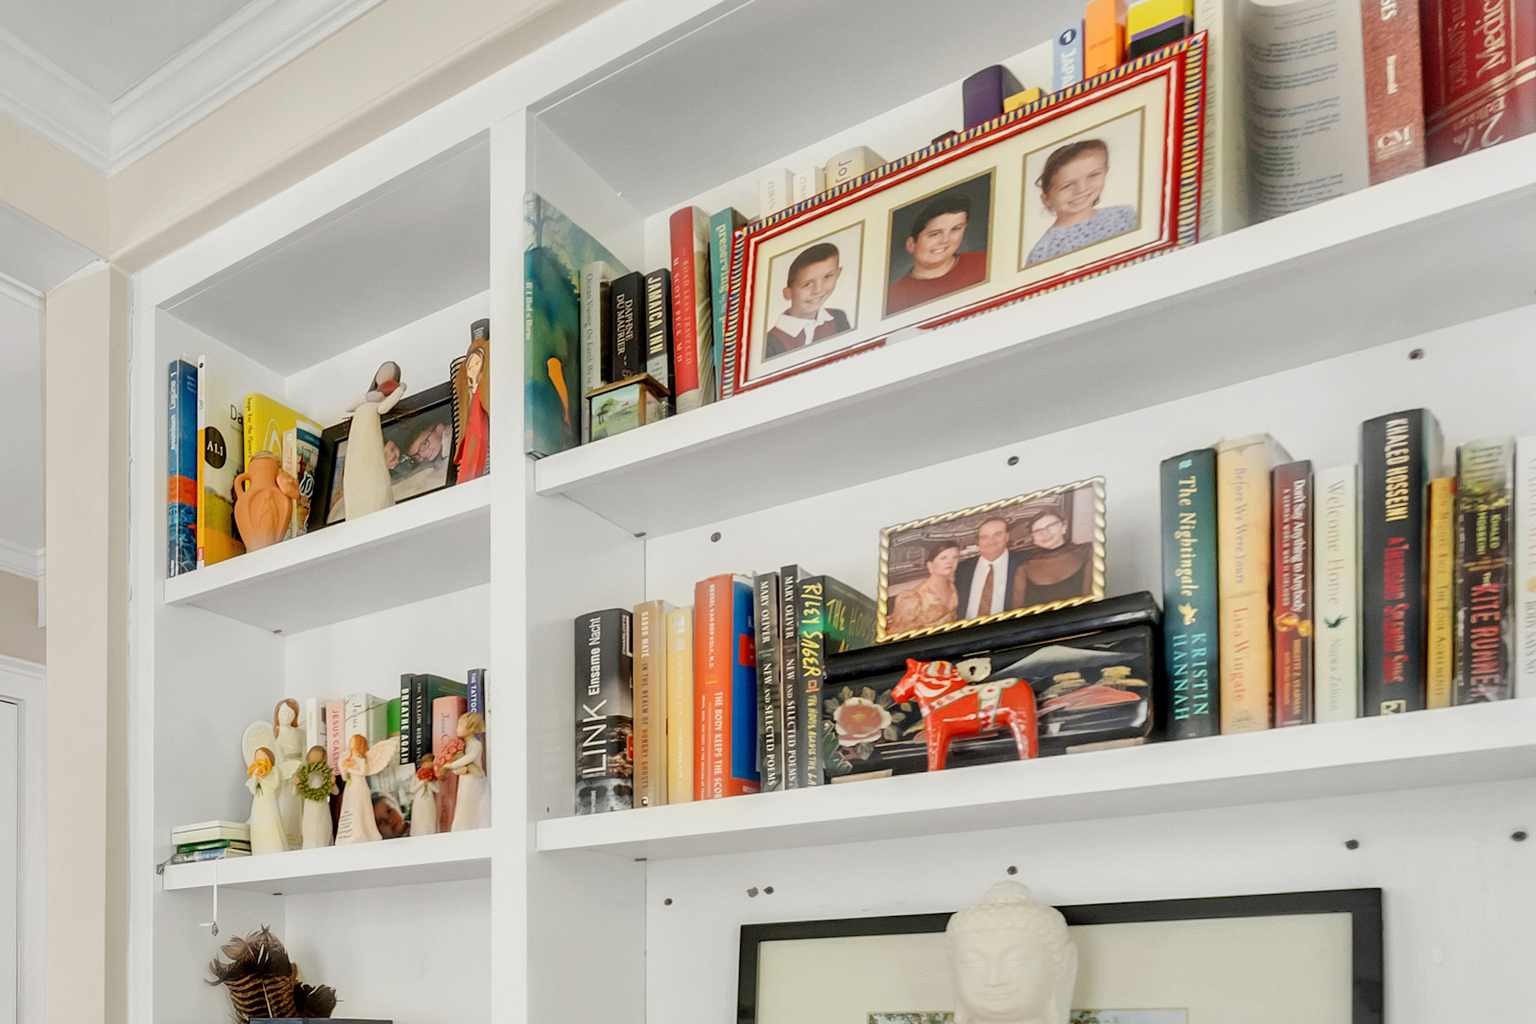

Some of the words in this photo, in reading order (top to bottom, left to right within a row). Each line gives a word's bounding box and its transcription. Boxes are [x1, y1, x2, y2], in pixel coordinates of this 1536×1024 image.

[715, 223, 728, 295] preserving
[586, 273, 594, 299] Ocean
[583, 299, 594, 328] Vuong
[616, 293, 625, 312] DU
[648, 276, 663, 329] JAMAICA
[586, 329, 594, 341] On
[617, 311, 626, 355] MAURIER
[625, 298, 634, 342] DAPHNE
[586, 342, 594, 361] Earth
[649, 330, 664, 355] INN
[170, 380, 178, 411] Lagune
[207, 440, 224, 457] A1.1
[1384, 418, 1410, 466] KHALED
[1177, 475, 1197, 507] The
[1233, 467, 1248, 502] Before
[1384, 465, 1410, 523] HOSSEINI
[1233, 503, 1248, 521] We
[1326, 479, 1347, 552] Welcome
[1233, 523, 1248, 552] Were
[1291, 521, 1306, 562] Anything
[1475, 512, 1488, 556] HOSSEINI
[1489, 513, 1501, 550] KHALED
[1174, 512, 1200, 598] Nightingale
[1234, 554, 1248, 585] Yours
[1327, 558, 1347, 605] Home
[1383, 543, 1410, 601] THOUSAND
[760, 580, 769, 607] MARY
[784, 575, 794, 602] MARY
[800, 582, 824, 625] RILEY
[1291, 573, 1305, 612] Anybody
[1471, 583, 1501, 625] KITE
[640, 611, 649, 638] GABOR
[761, 608, 770, 644] OLIVER
[784, 603, 794, 640] OLIVER
[826, 598, 846, 632] THE
[1233, 606, 1250, 637] Lisa
[1382, 602, 1410, 654] SPLENDID
[588, 616, 602, 647] Nacht
[786, 658, 796, 681] NEW
[801, 630, 824, 678] SAGER
[1469, 625, 1501, 700] RUNNER
[587, 646, 601, 697] Einsame
[641, 673, 649, 688] THE
[763, 662, 773, 686] NEW
[1172, 633, 1191, 721] HANNAH
[1191, 632, 1209, 716] KRISTIN
[1230, 638, 1250, 702] Wingate
[641, 688, 649, 715] REALM
[714, 691, 724, 707] THE
[764, 687, 772, 703] AND
[786, 683, 795, 699] AND
[331, 709, 340, 738] JESUS
[352, 702, 362, 729] Jesus
[400, 687, 410, 731] BREATHE
[641, 715, 649, 726] OF
[714, 709, 724, 732] BODY
[786, 700, 797, 748] SELECTED
[807, 707, 818, 730] HOUSE
[582, 698, 608, 775] LINK
[641, 728, 649, 758] HUNGRY
[764, 702, 776, 756] SELECTED
[806, 730, 818, 755] ACROSS
[400, 734, 410, 764] AGAIN
[714, 733, 724, 758] KEEPS
[641, 759, 649, 789] GHOSTS
[713, 759, 723, 776] THE
[767, 757, 777, 787] POEMS
[787, 748, 798, 783] POEMS
[806, 755, 817, 771] THE
[713, 777, 723, 800] SCOR
